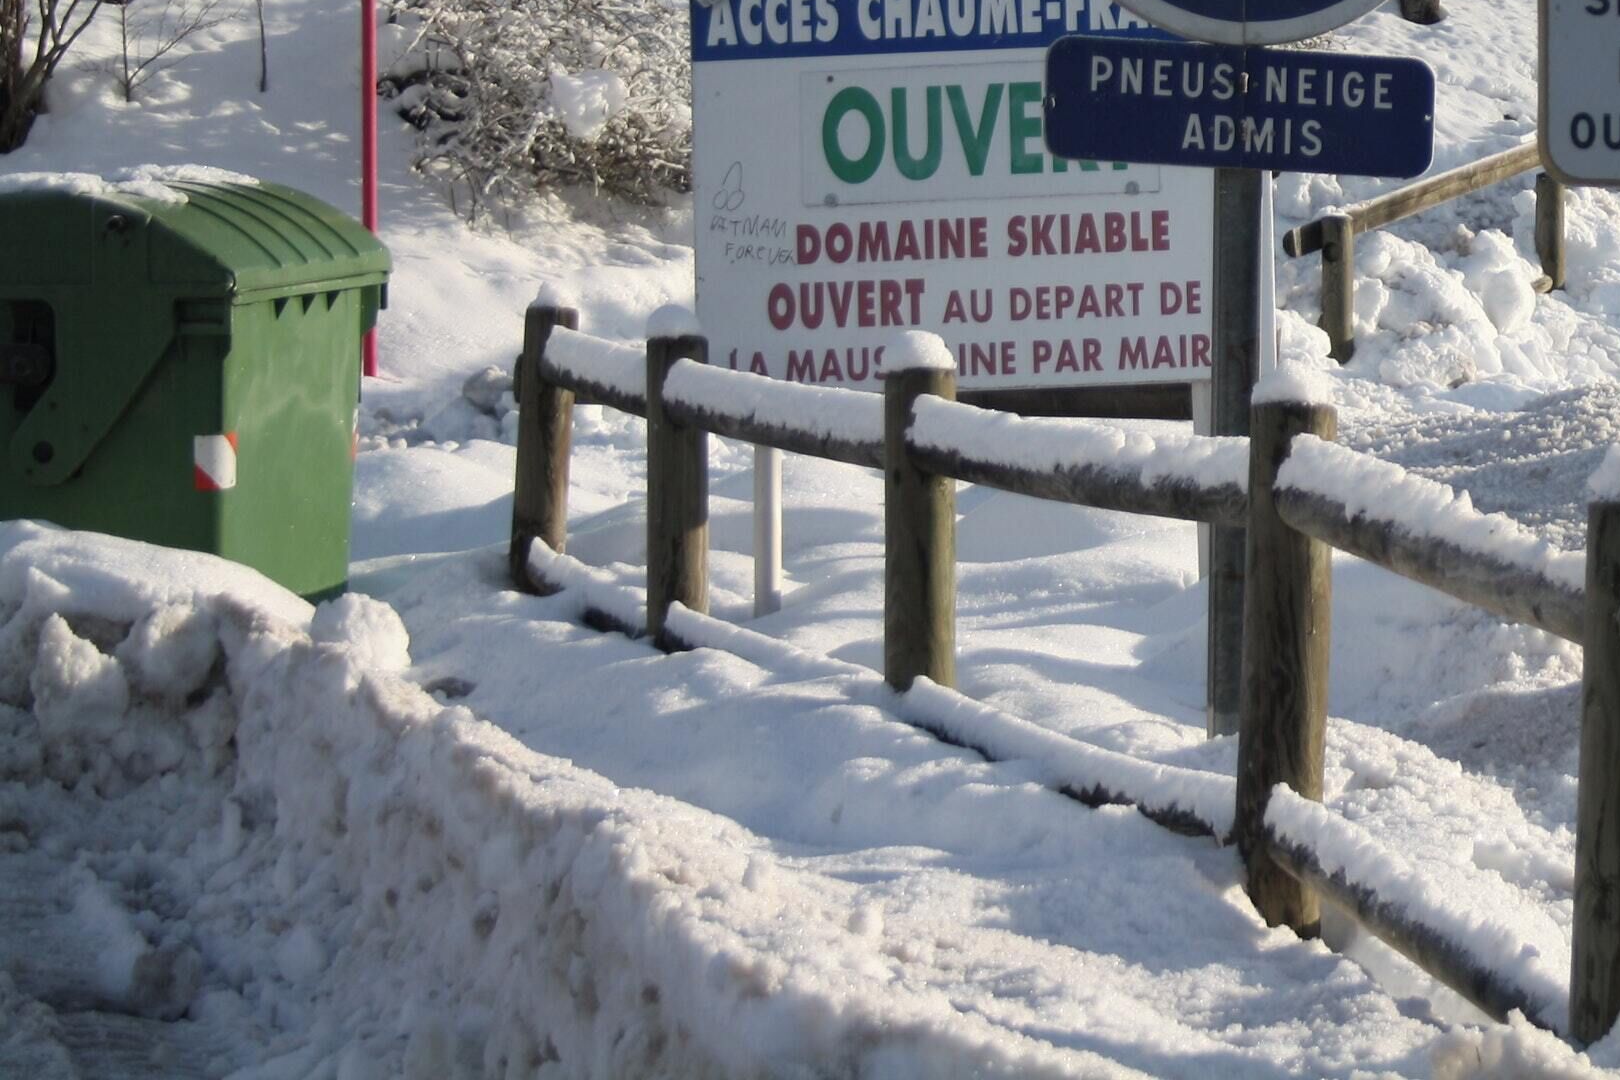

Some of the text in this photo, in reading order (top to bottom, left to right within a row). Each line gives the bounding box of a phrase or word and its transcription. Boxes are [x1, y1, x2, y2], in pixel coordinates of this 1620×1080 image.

[1090, 56, 1393, 109] PNEUS NEIGE
[822, 81, 1129, 184] OUVE
[1182, 114, 1323, 157] ADMIS
[796, 210, 1171, 265] DOMAINE SKIABLE
[767, 278, 1201, 331] OUVERT AU DEPART DE
[785, 341, 1017, 383] MAUSINE
[1033, 338, 1105, 374] PAR
[1118, 334, 1212, 370] MAIR
